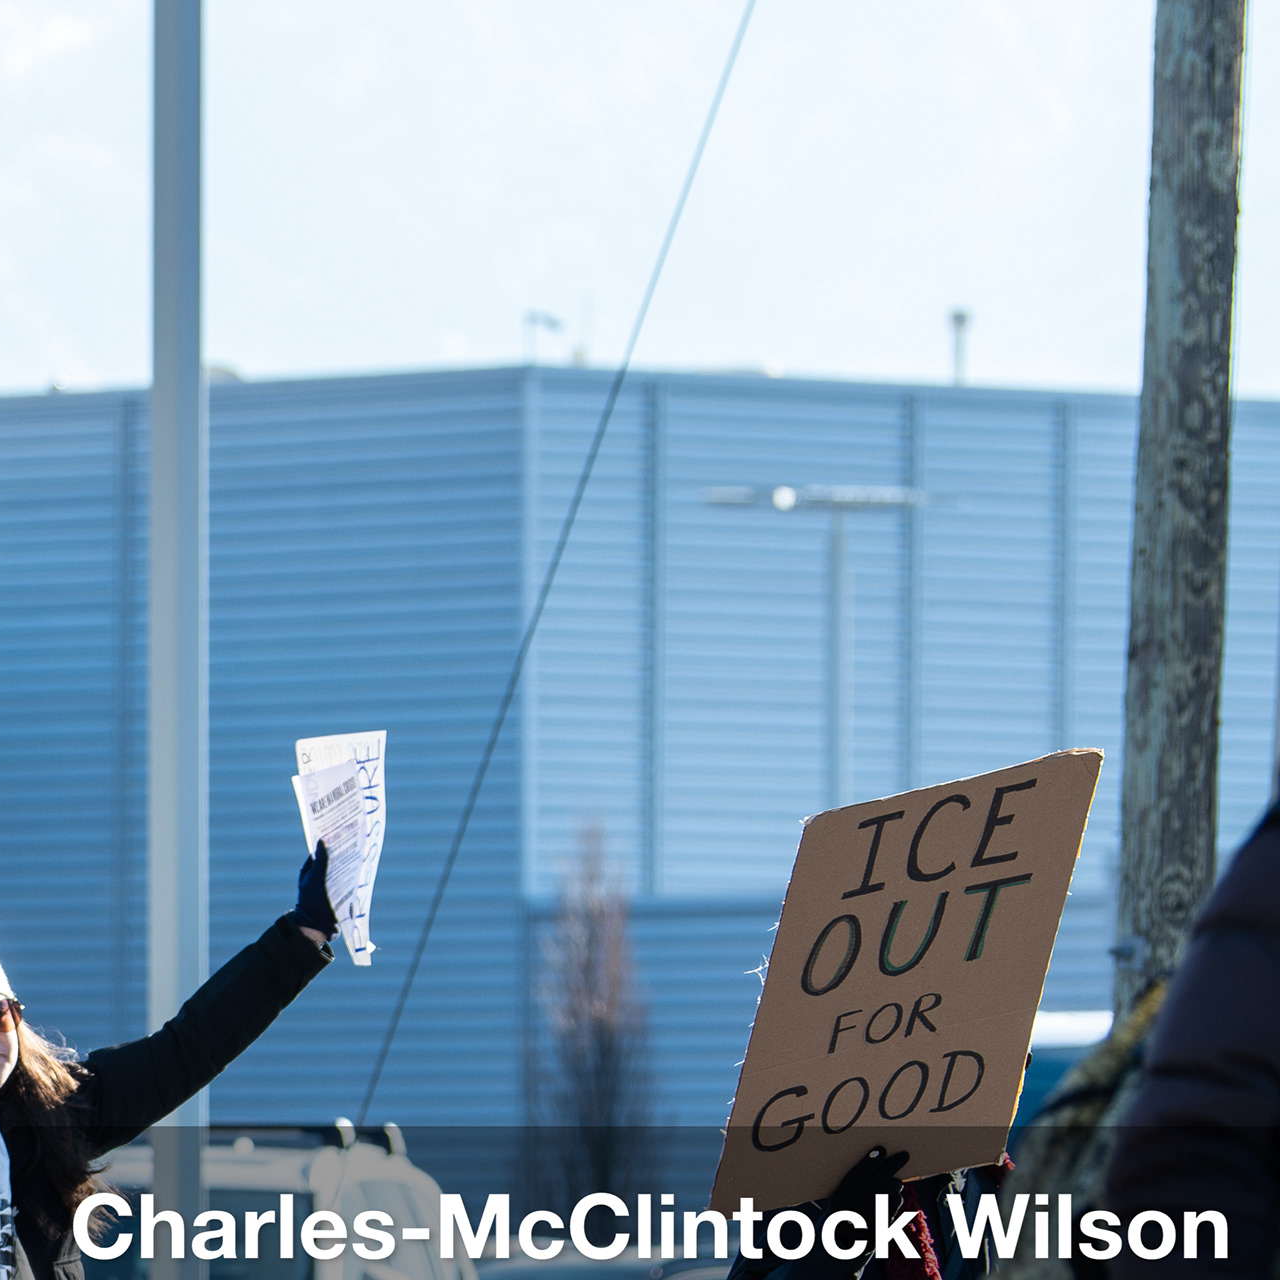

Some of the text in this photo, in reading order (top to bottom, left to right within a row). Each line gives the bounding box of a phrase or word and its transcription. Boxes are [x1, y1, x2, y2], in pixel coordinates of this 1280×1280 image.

[841, 777, 1038, 900] ICE
[801, 872, 1034, 997] OUT
[828, 993, 943, 1055] FOR
[751, 1050, 986, 1153] GOOD
